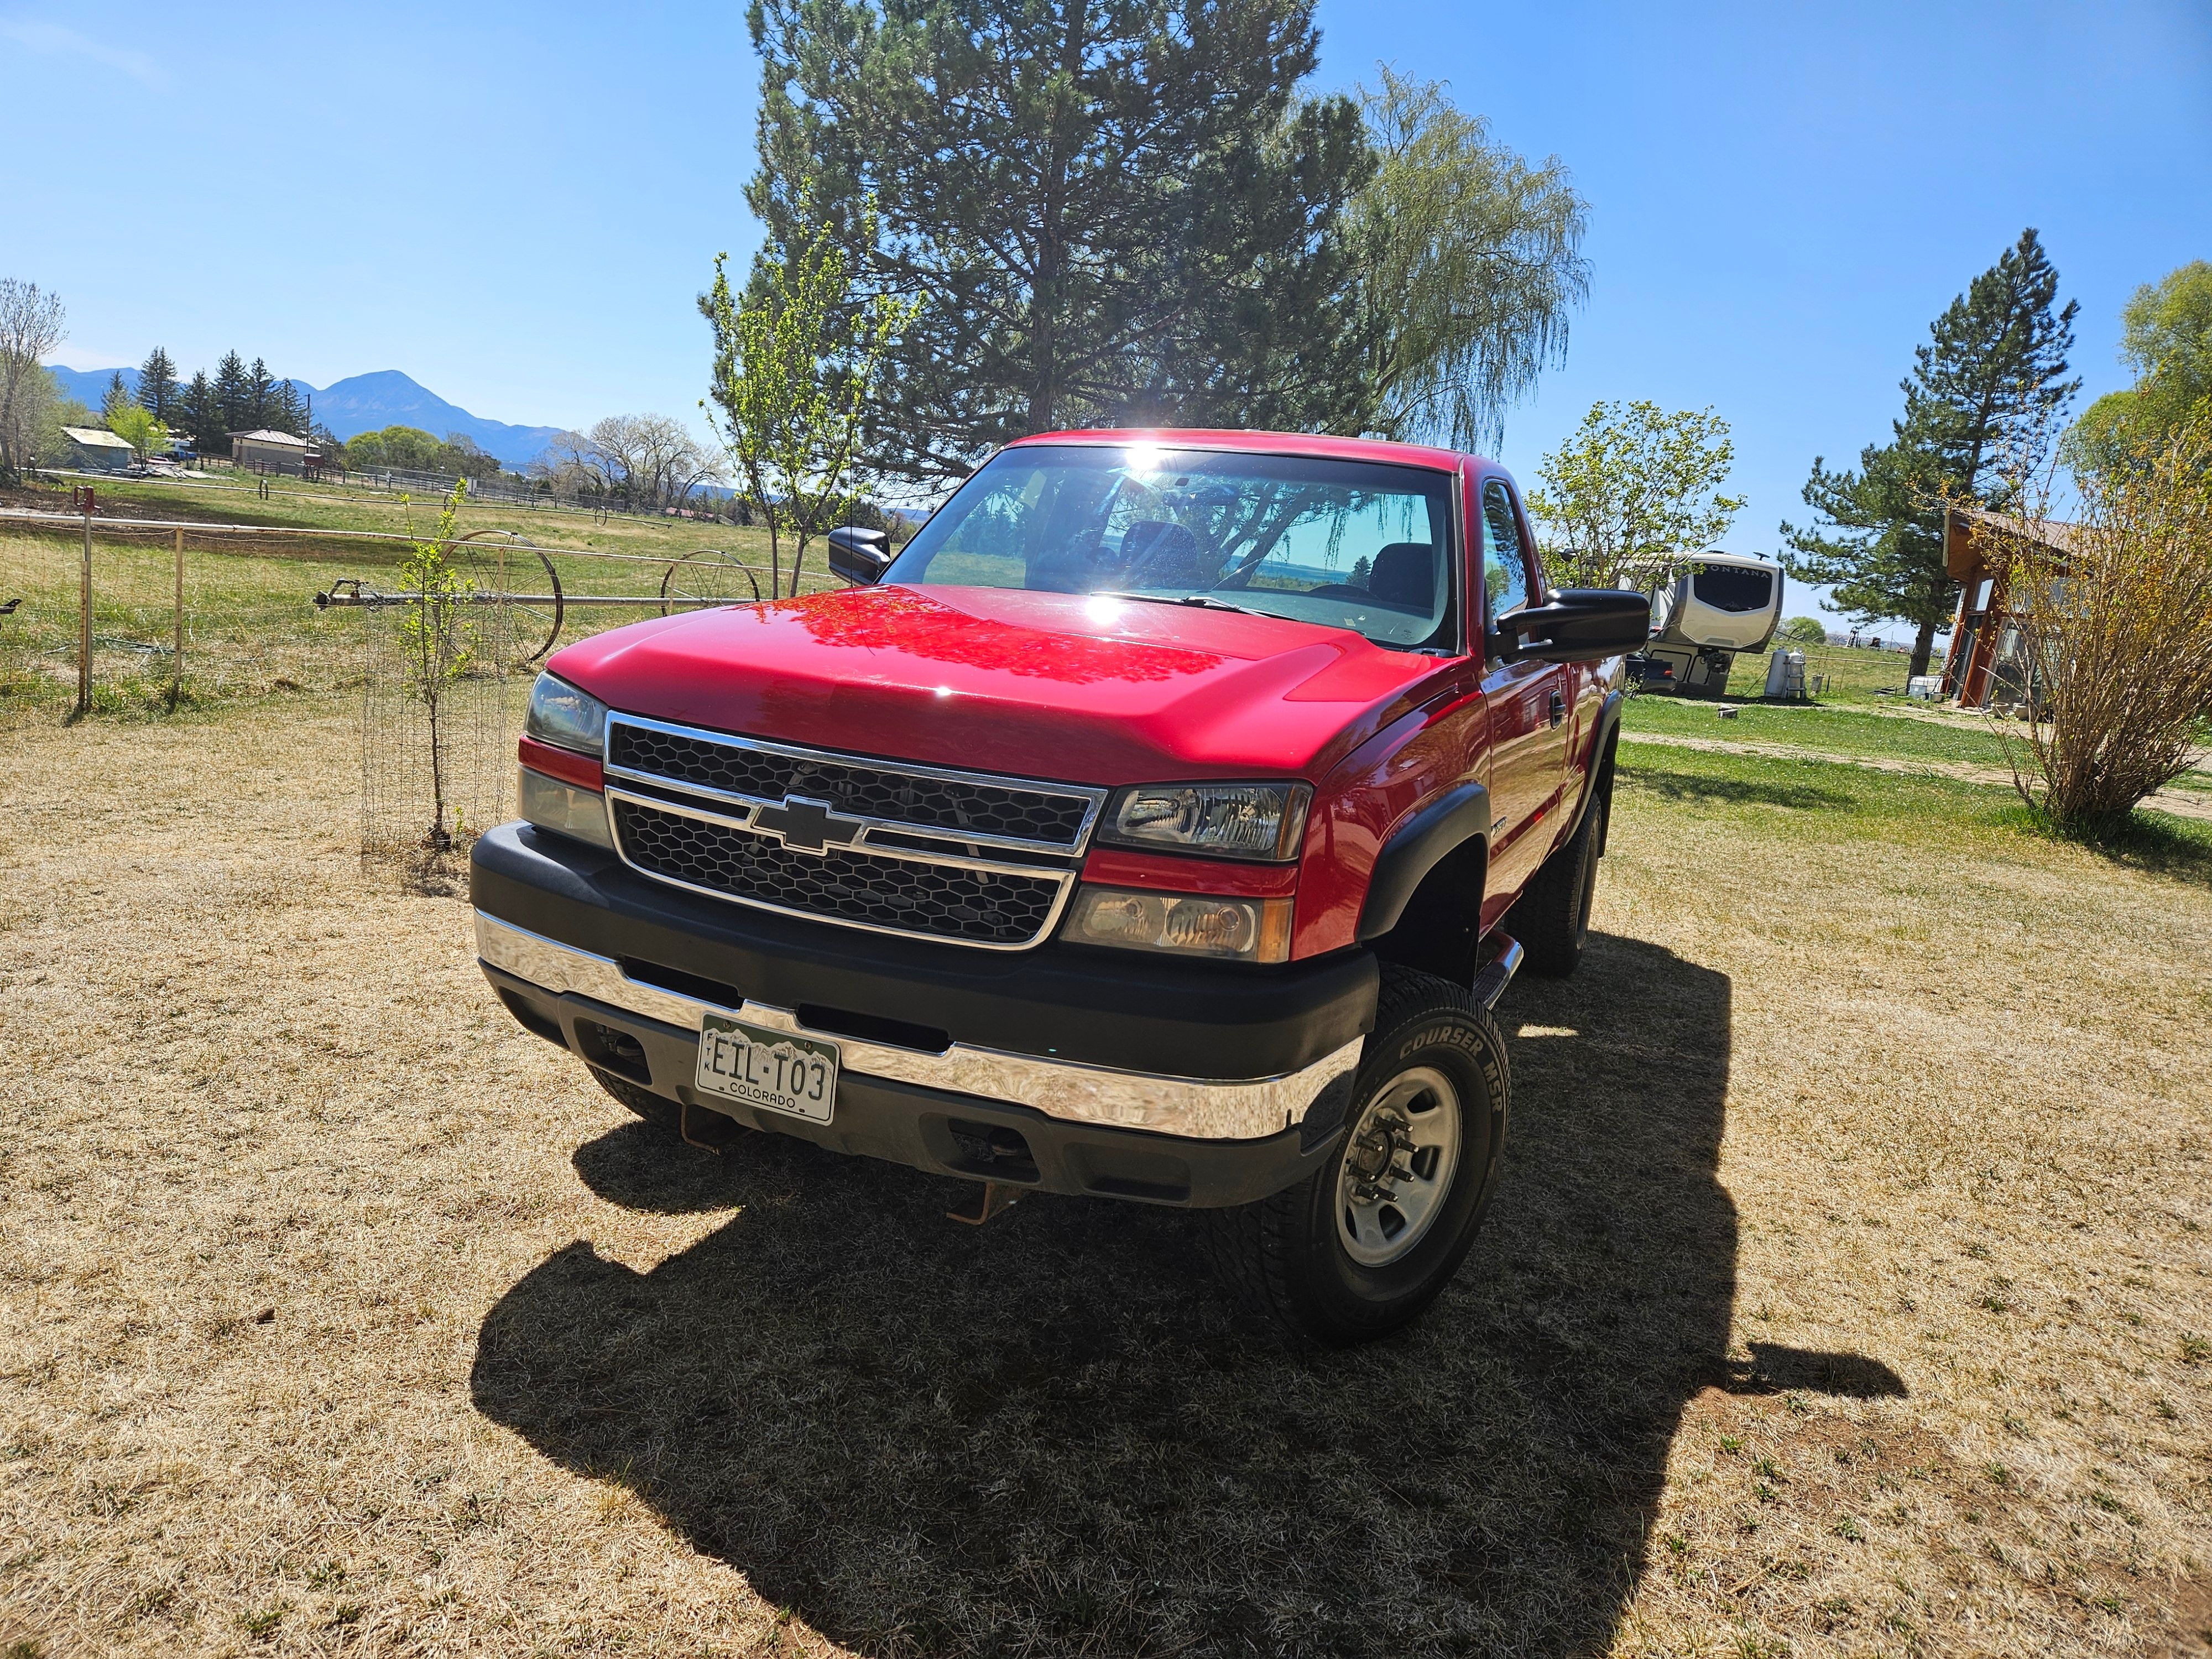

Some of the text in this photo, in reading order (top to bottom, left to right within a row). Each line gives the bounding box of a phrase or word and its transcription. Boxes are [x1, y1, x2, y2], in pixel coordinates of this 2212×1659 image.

[729, 1082, 795, 1108] COLORADO
[1400, 1026, 1503, 1112] COURSER MSR
